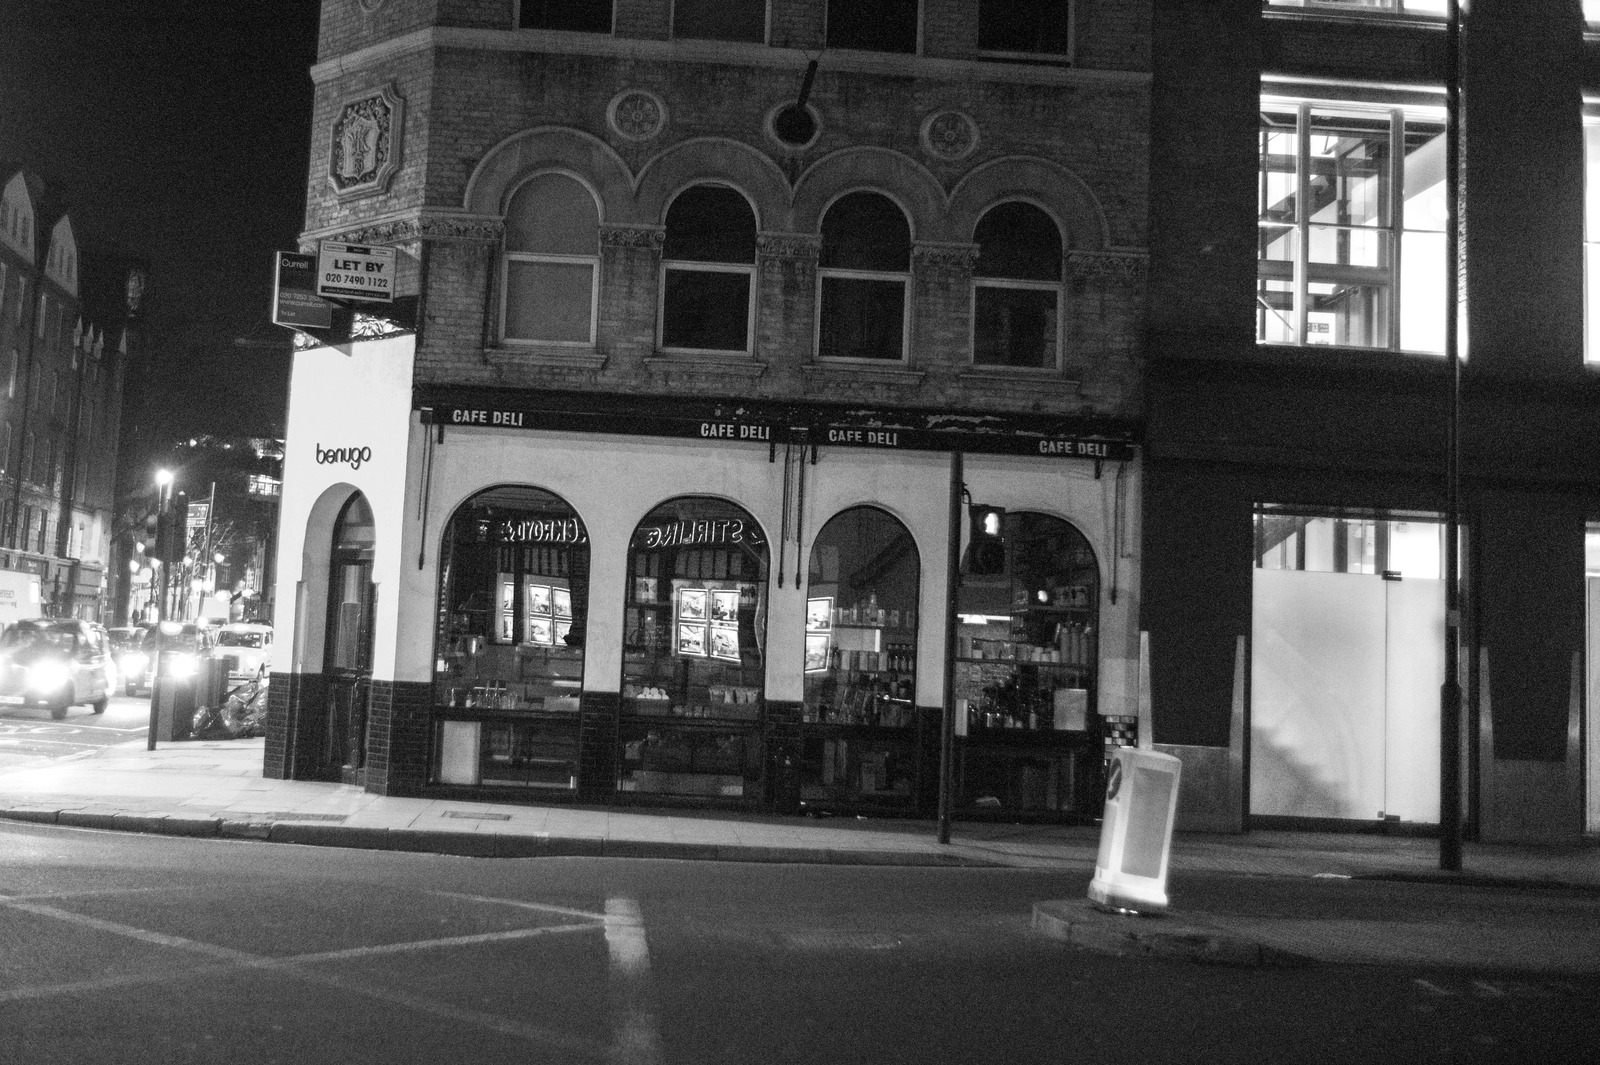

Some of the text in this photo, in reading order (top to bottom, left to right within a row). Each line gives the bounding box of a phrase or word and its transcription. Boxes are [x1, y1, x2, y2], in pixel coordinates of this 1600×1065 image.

[281, 258, 309, 270] Currell
[334, 259, 384, 273] LET BY
[325, 273, 388, 288] 020 7490 1122
[452, 409, 524, 427] CAFE DELI
[700, 423, 770, 440] CAFE DELI
[828, 429, 898, 446] CAFE DELI
[315, 443, 372, 470] benugo
[1039, 440, 1107, 457] CAFE DELI
